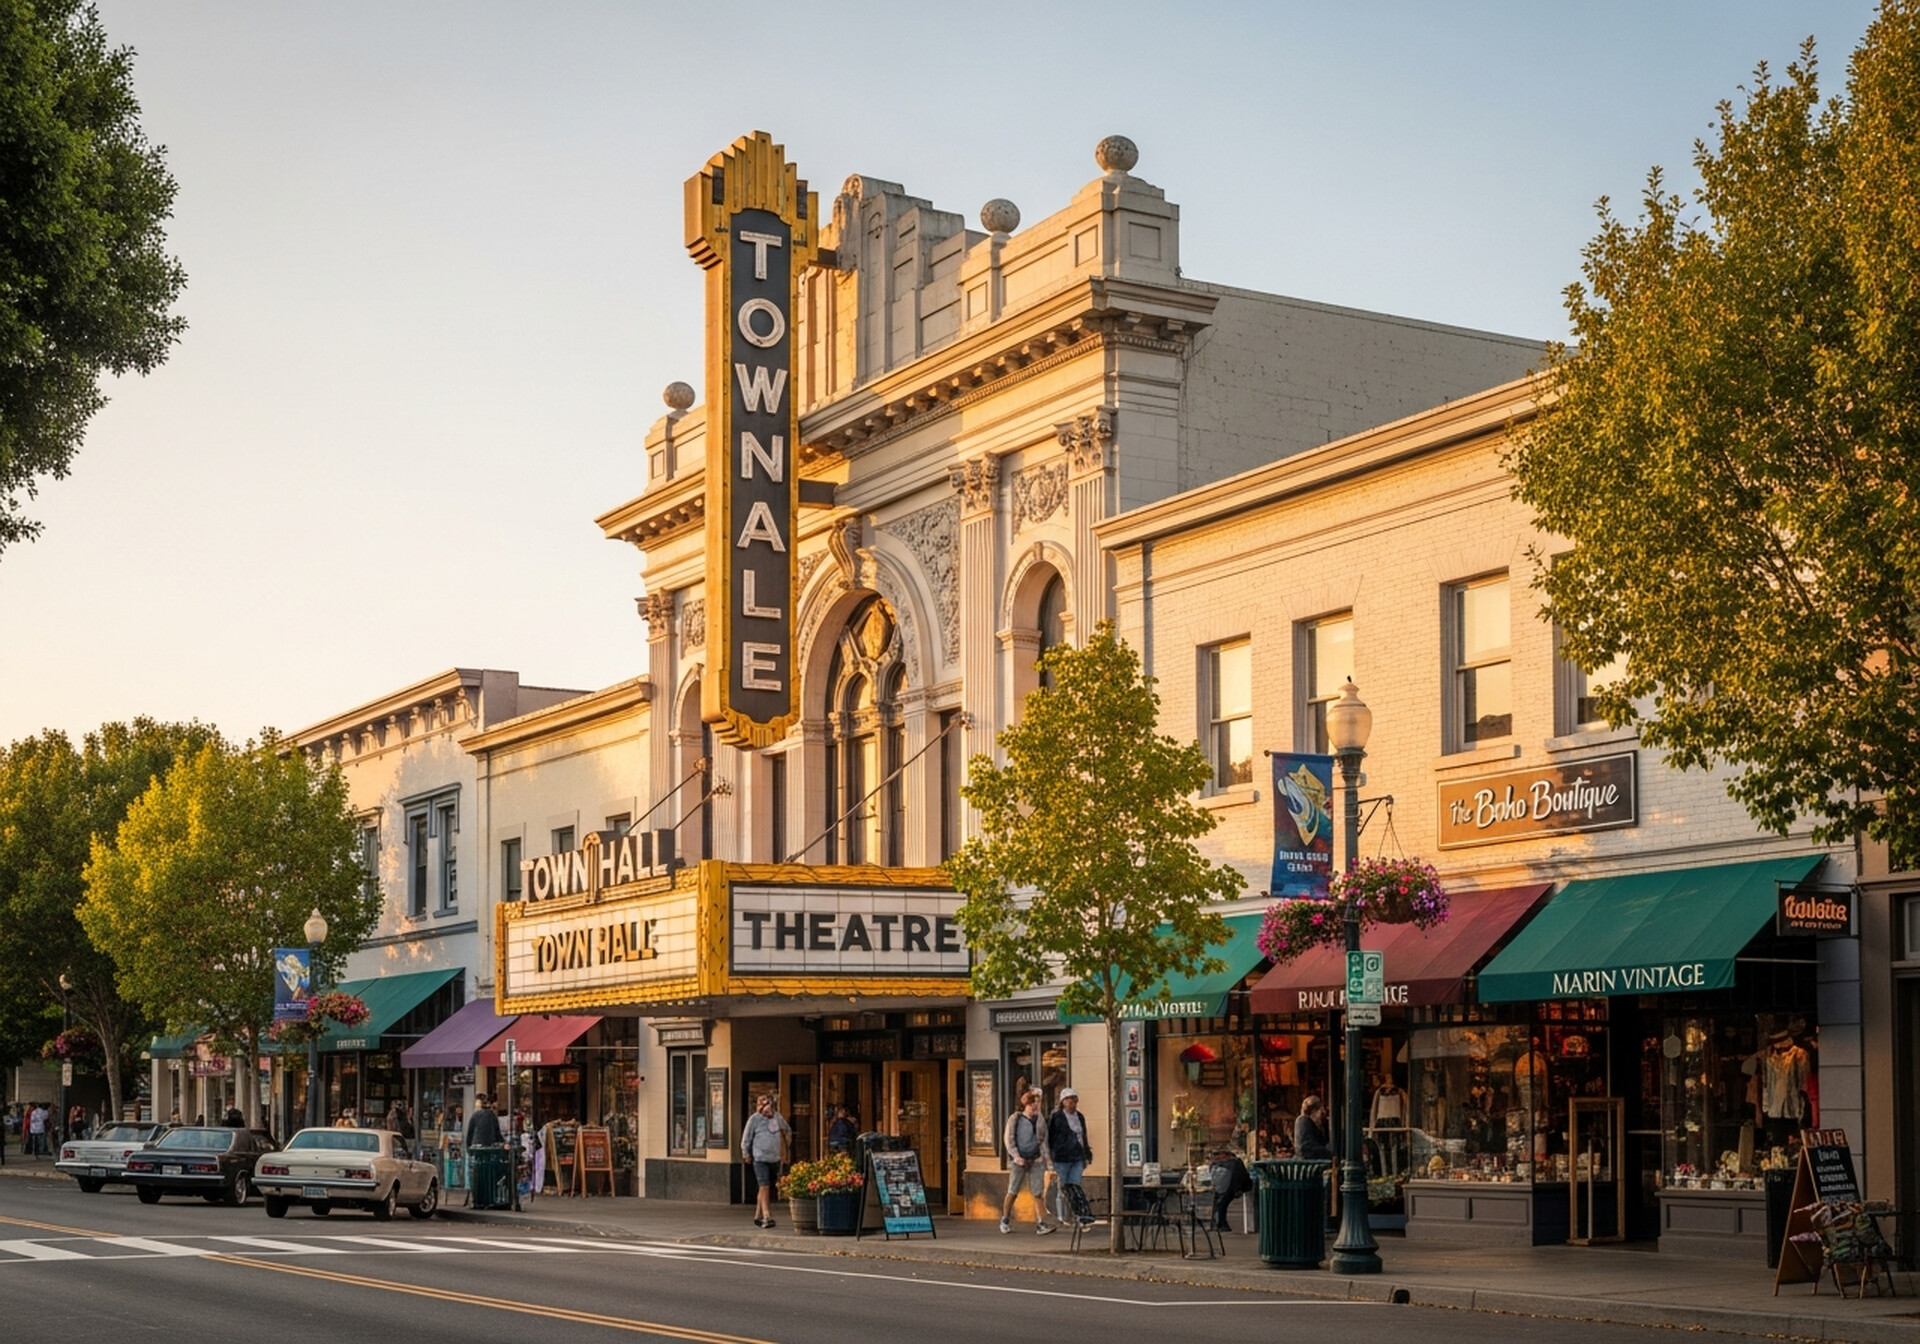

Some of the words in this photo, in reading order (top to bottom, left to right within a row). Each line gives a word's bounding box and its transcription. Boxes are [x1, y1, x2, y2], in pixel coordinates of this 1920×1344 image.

[735, 230, 788, 692] TOWNALE
[1474, 785, 1528, 829] Boho
[520, 849, 589, 903] TOWN
[599, 829, 668, 889] HALL
[531, 927, 592, 973] TOWN
[743, 911, 961, 952] THEATRE
[1553, 970, 1617, 994] MARIN
[1621, 963, 1705, 990] VINTAGE
